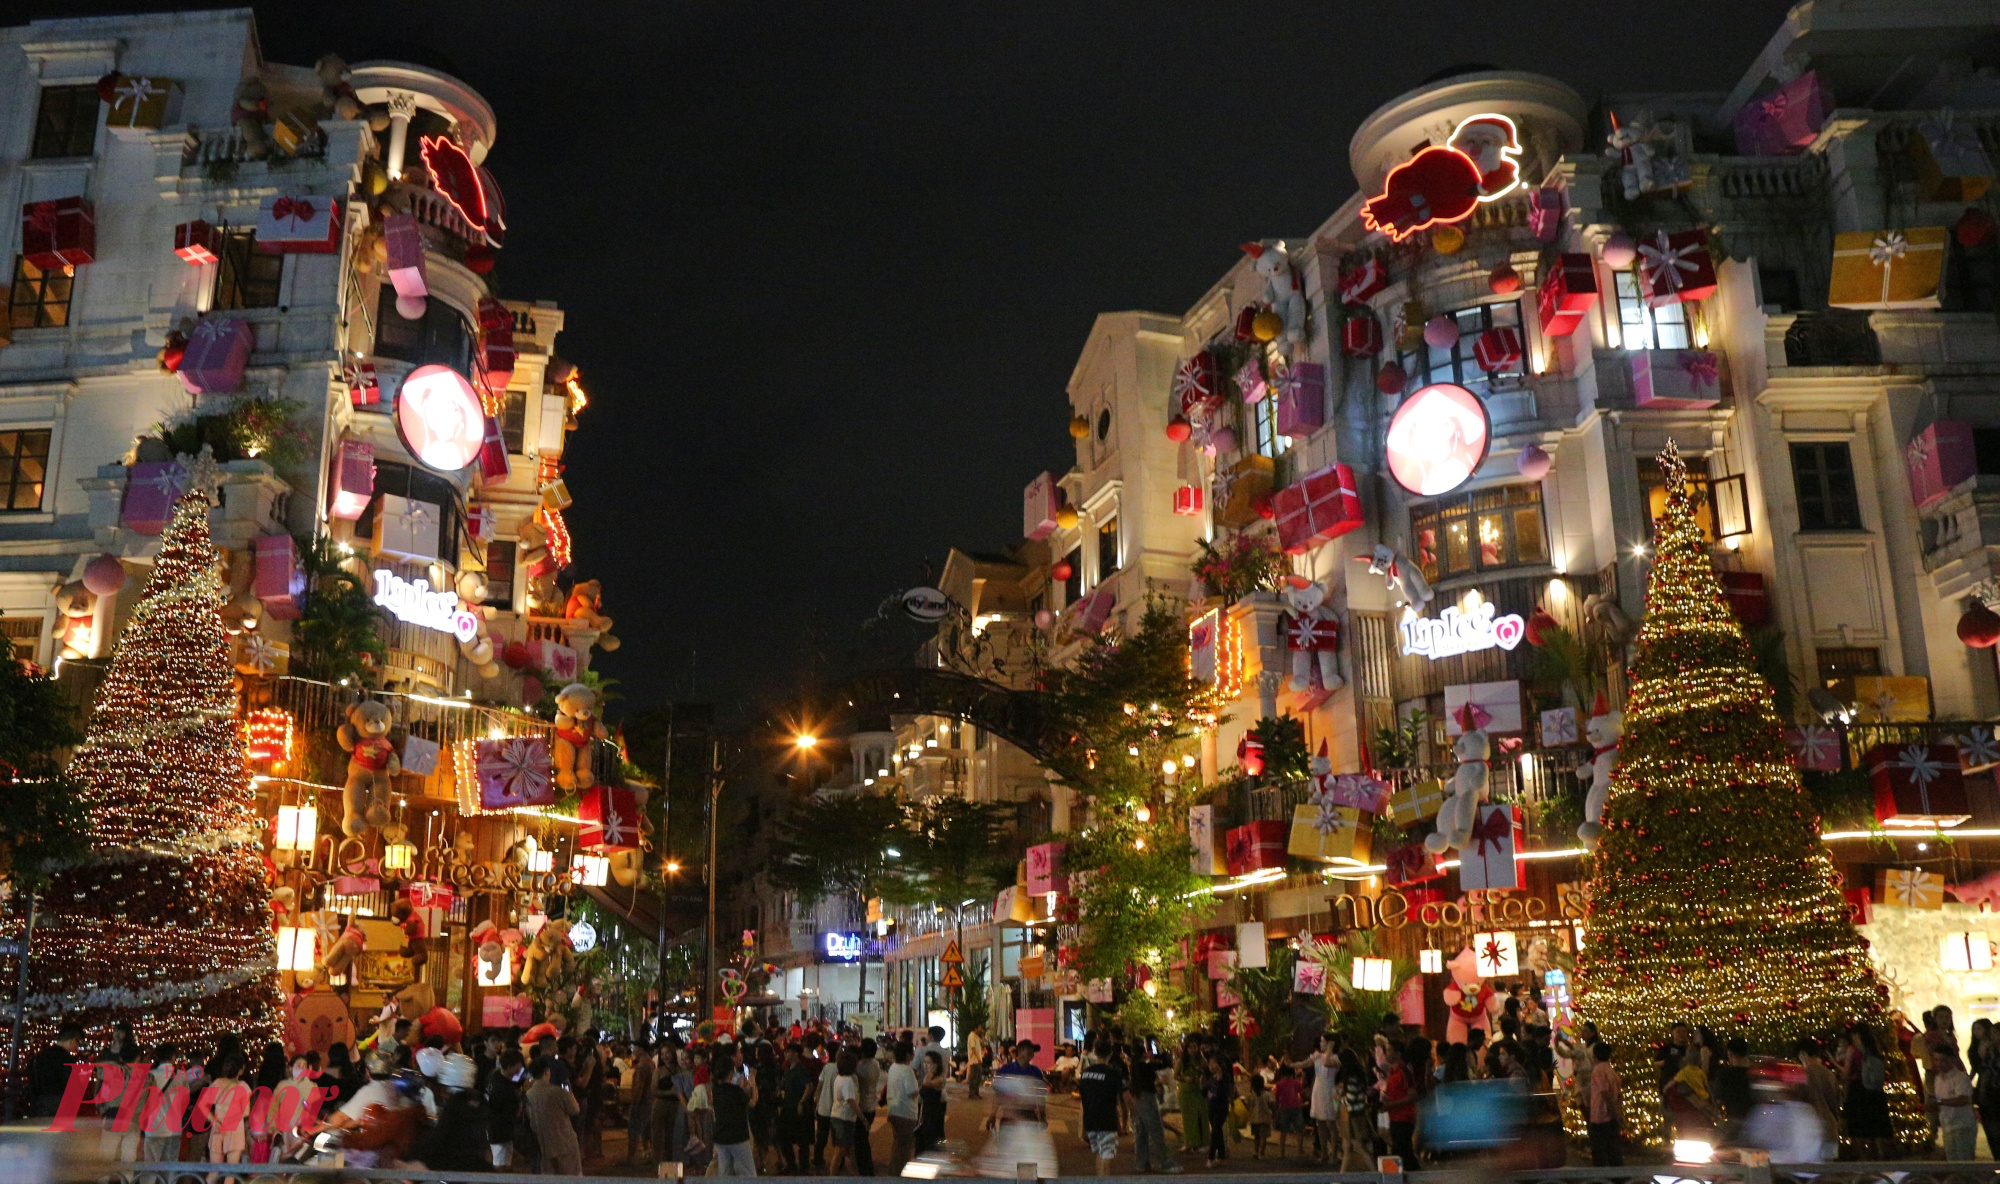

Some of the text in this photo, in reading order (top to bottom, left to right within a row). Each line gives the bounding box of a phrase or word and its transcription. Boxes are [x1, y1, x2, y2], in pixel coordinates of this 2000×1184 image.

[1400, 602, 1495, 660] LipIce
[379, 845, 487, 888] coffee
[501, 864, 523, 892] &
[1420, 889, 1547, 930] coffee
